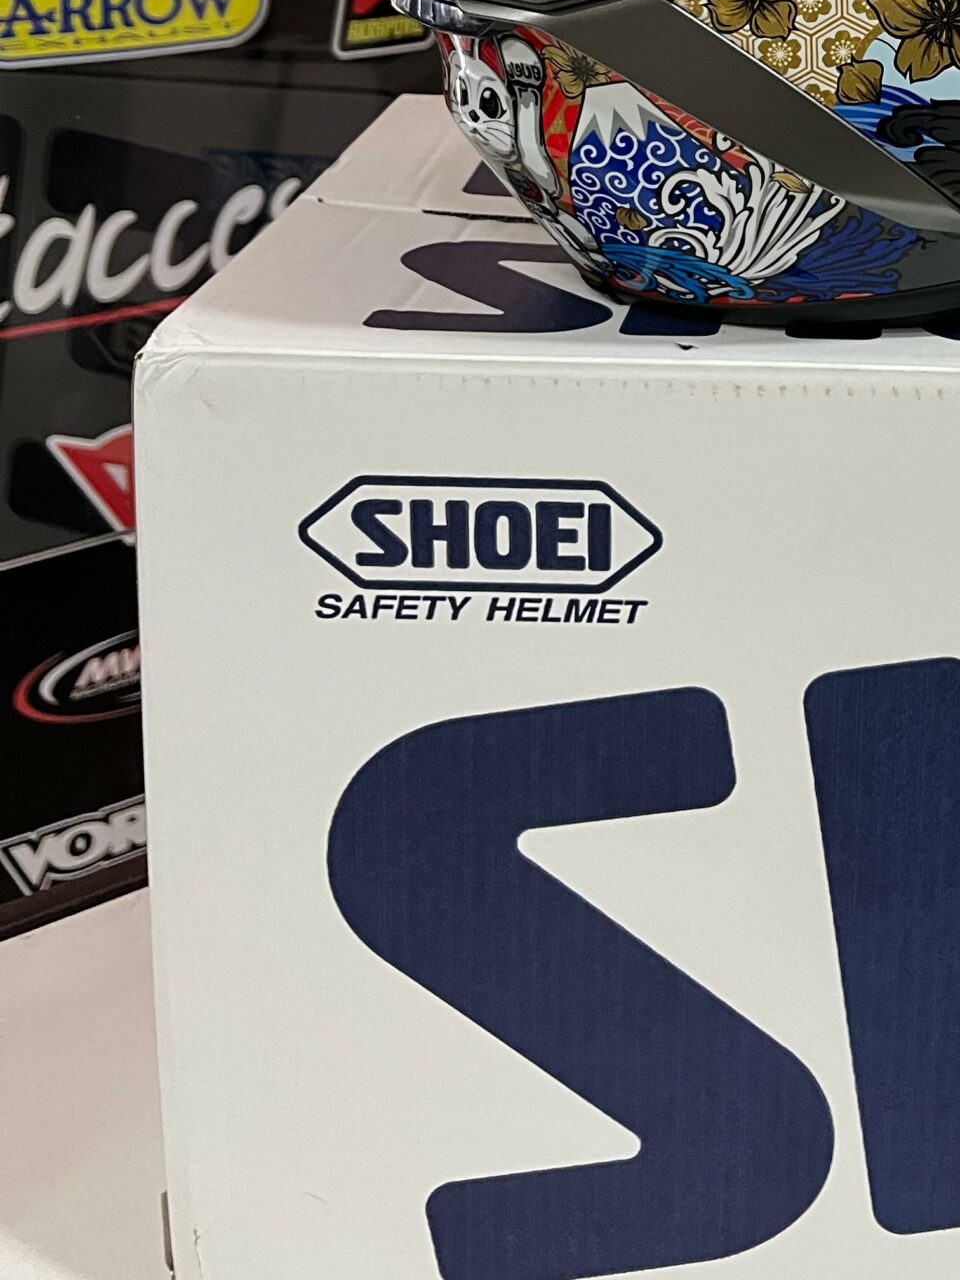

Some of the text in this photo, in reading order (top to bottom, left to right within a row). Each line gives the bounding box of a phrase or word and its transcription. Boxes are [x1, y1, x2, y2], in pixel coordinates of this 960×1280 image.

[350, 498, 612, 572] SHOEI
[314, 593, 649, 624] SAFETY HELMET
